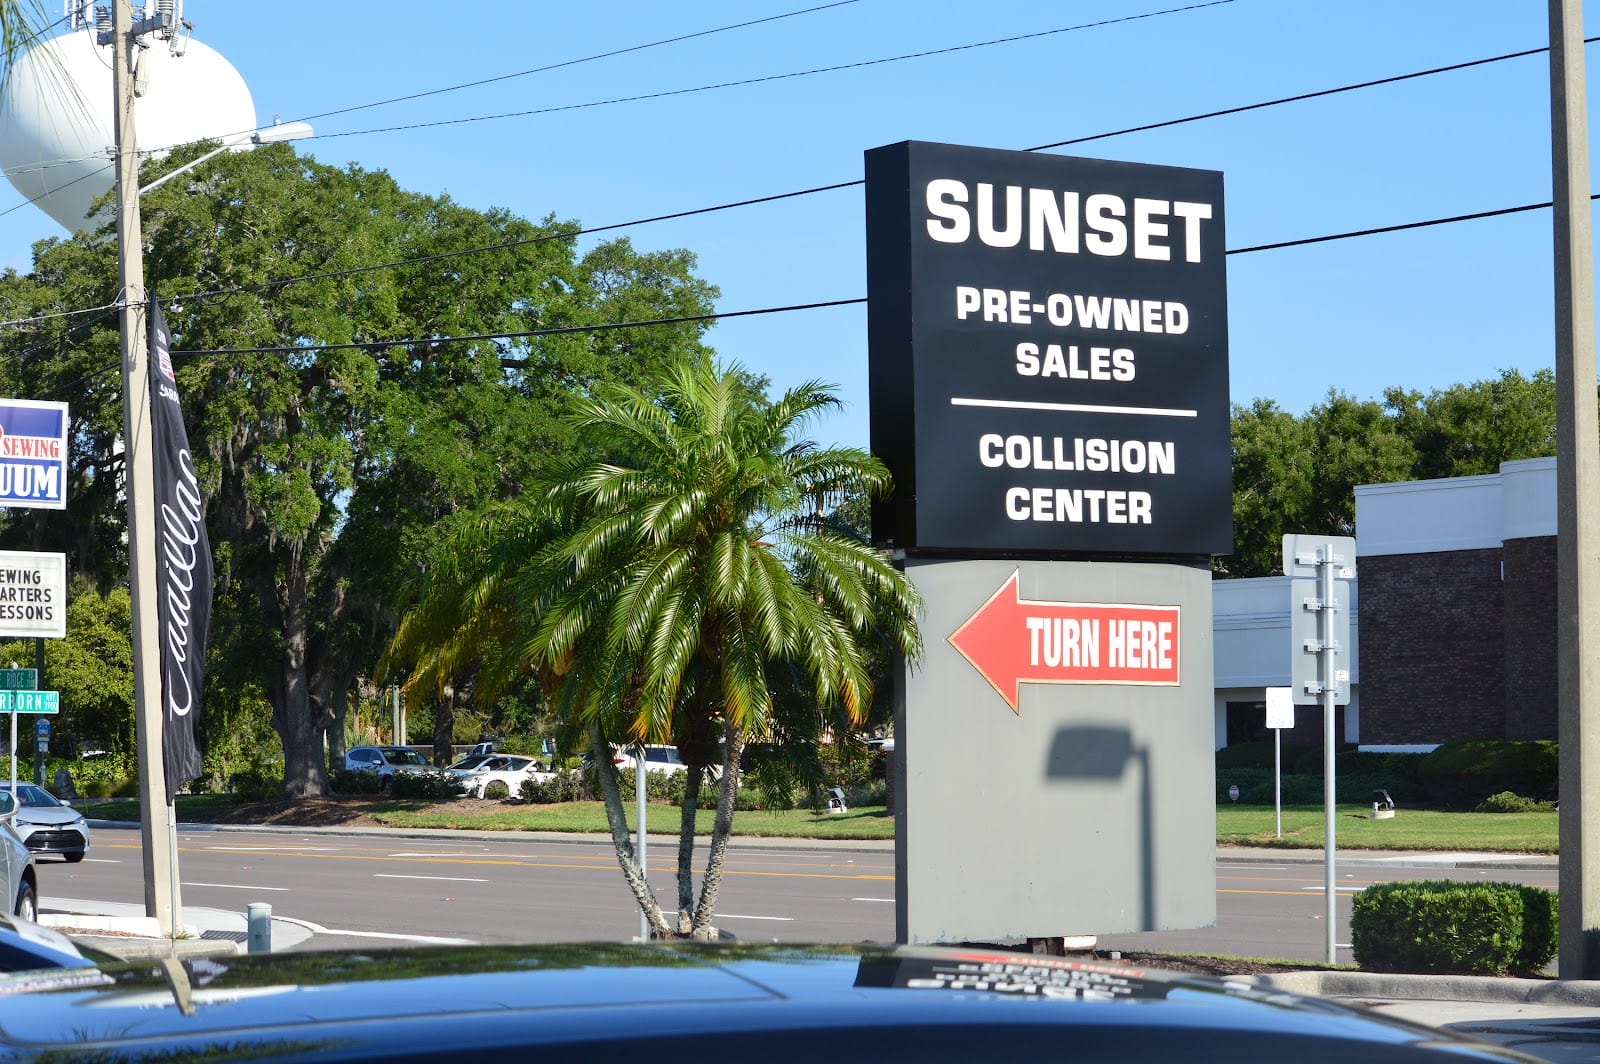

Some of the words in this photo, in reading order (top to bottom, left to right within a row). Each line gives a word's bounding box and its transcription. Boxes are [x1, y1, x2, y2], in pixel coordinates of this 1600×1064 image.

[926, 179, 1212, 263] SUNSET
[956, 286, 1189, 335] PRE-OWNED
[1016, 342, 1136, 382] SALES
[3, 437, 60, 458] SEWING
[979, 434, 1176, 474] COLLISION
[1005, 487, 1152, 524] CENTER
[0, 587, 52, 602] ARTERS
[0, 605, 53, 620] ESSONS
[1026, 616, 1100, 668] TURN
[1108, 619, 1173, 669] HERE
[6, 672, 24, 688] RIDGE
